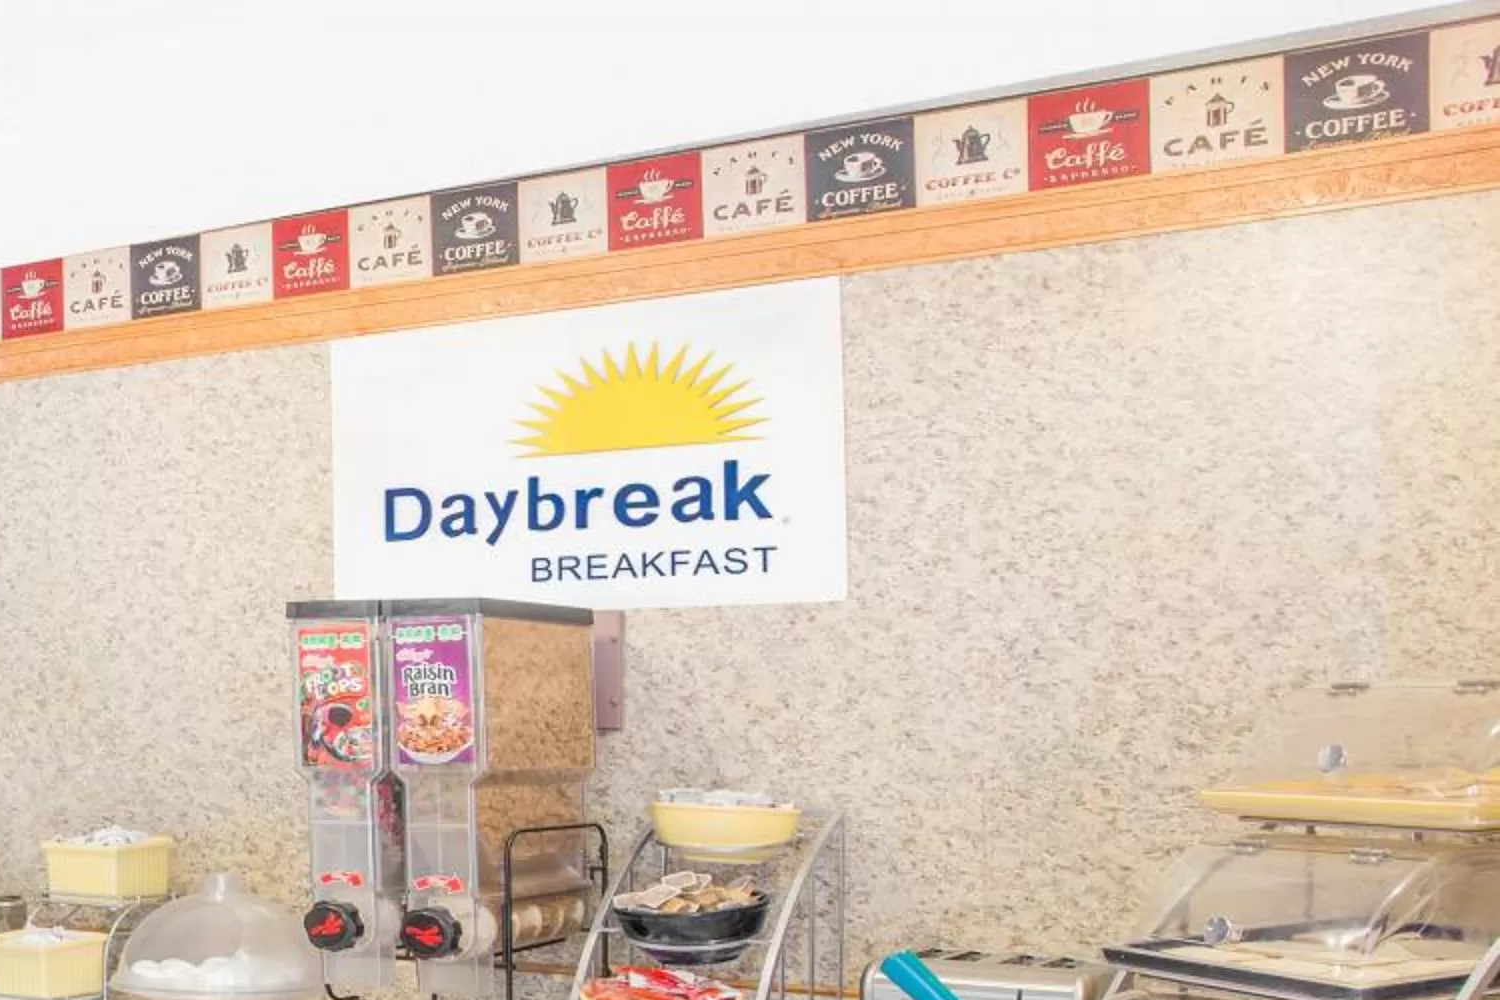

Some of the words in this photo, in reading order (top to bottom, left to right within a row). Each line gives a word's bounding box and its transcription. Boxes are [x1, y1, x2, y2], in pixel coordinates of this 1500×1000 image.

[1301, 56, 1352, 89] NEW
[1357, 53, 1414, 73] YORK
[1163, 118, 1269, 157] CAFÉ
[1304, 109, 1406, 139] COFFEE
[817, 134, 855, 162] NEW
[860, 132, 904, 152] YORK
[1044, 140, 1126, 170] Caffé
[441, 197, 472, 220] NEW
[475, 195, 510, 212] YORK
[713, 189, 795, 221] CAFÉ
[820, 183, 900, 208] COFFEE
[620, 205, 686, 231] Caffé
[358, 243, 423, 271] CAFÉ
[444, 239, 507, 261] COFFEE
[284, 256, 335, 279] Caffé
[69, 290, 124, 314] CAFÉ
[141, 285, 191, 305] COFFEE
[384, 460, 773, 546] Daybreak
[531, 546, 778, 583] BREAKFAST
[404, 663, 455, 683] Raisin
[409, 682, 449, 697] Bran
